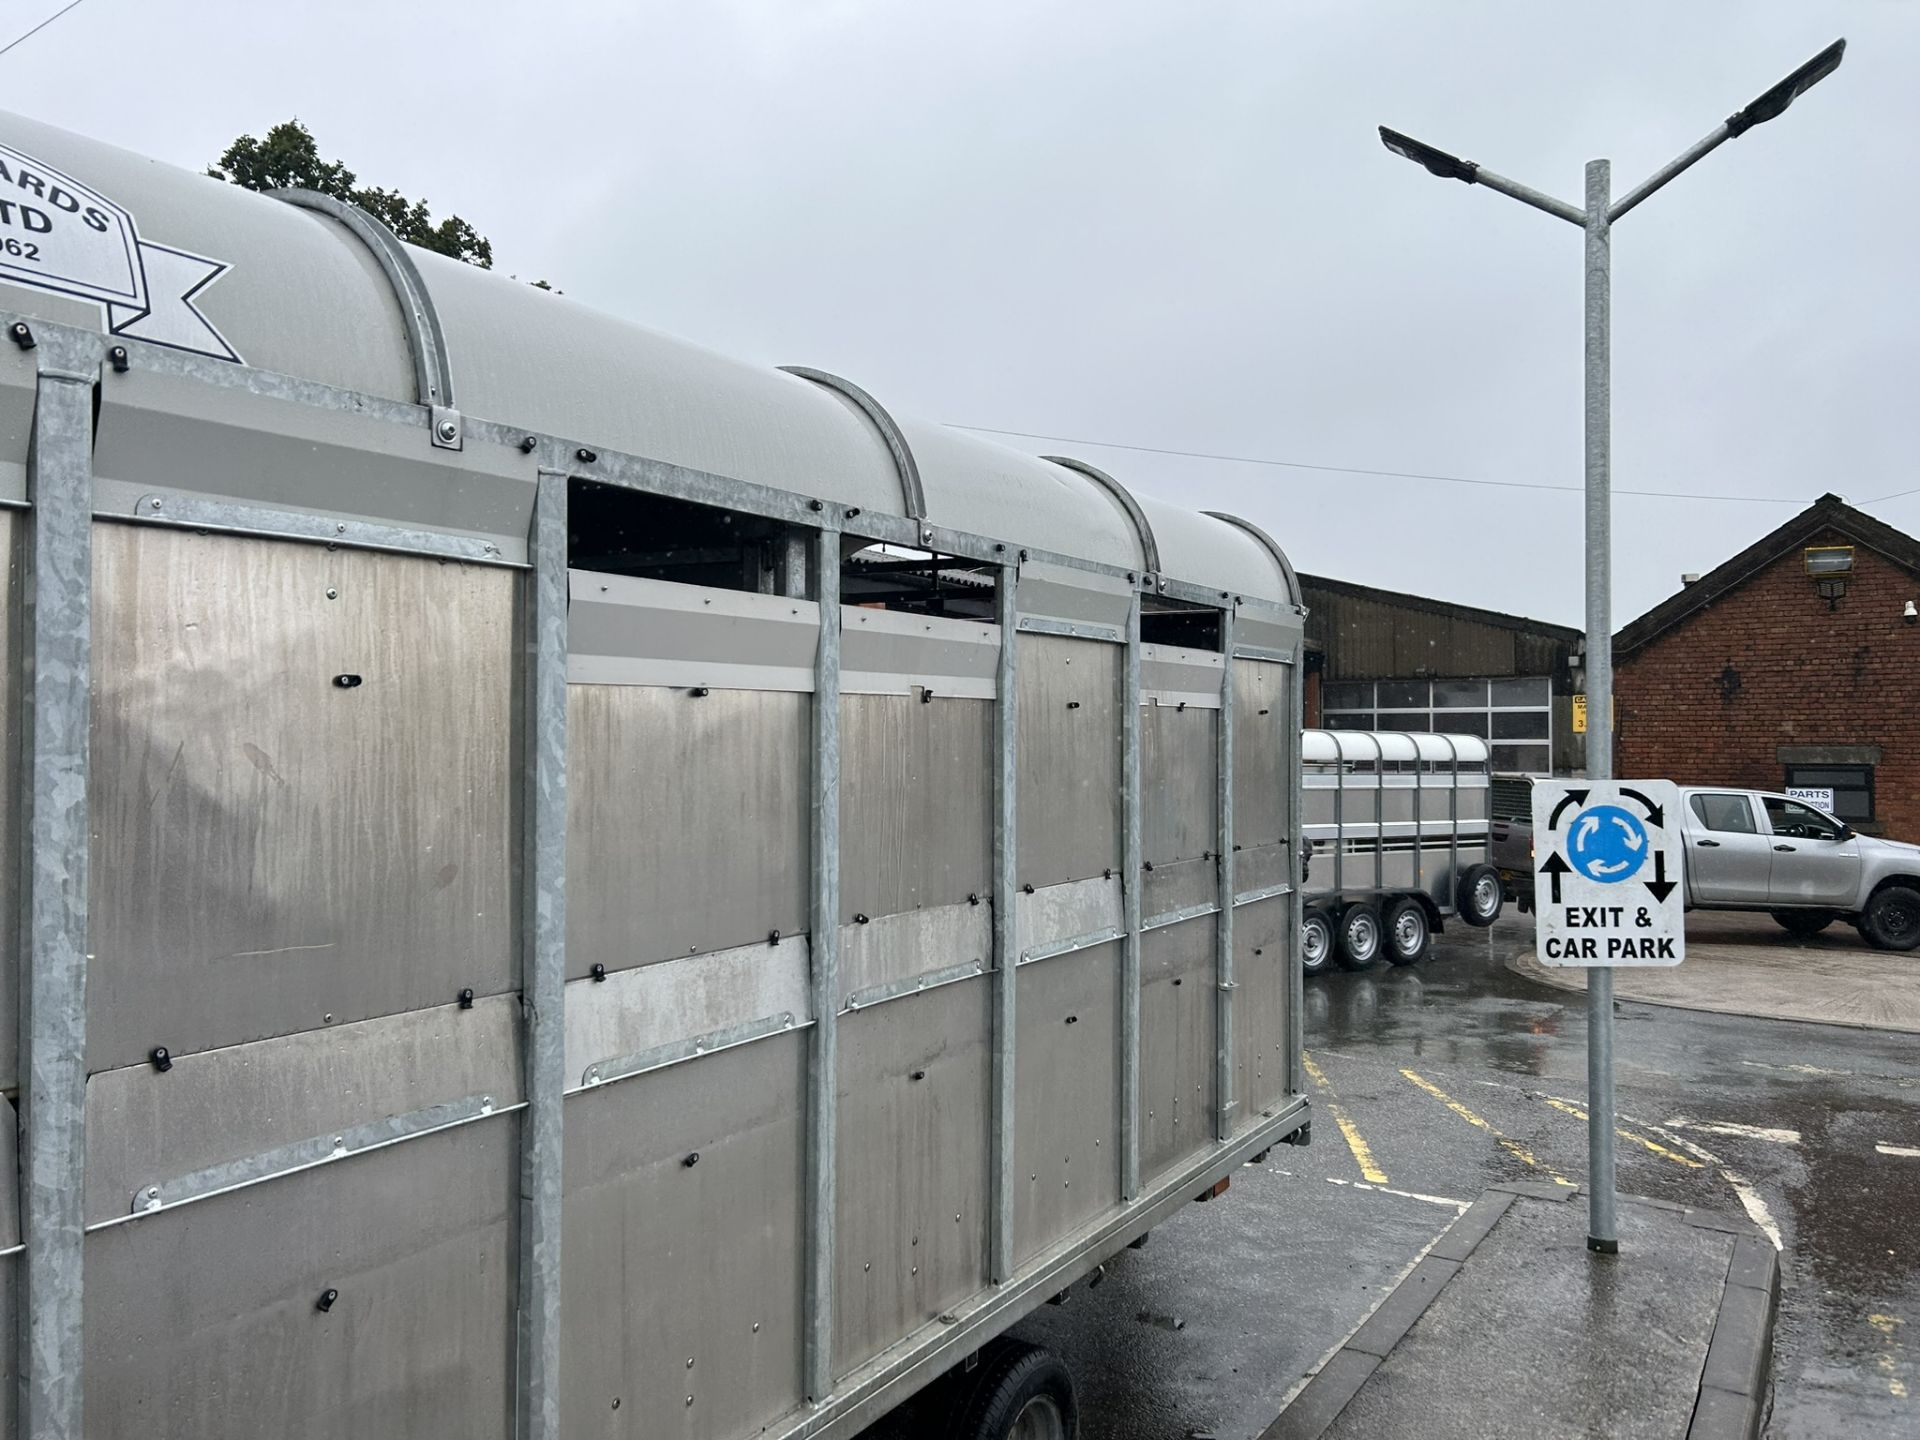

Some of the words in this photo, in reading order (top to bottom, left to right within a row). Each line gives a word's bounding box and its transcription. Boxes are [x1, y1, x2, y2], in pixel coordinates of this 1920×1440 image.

[0, 238, 40, 262] 62
[1790, 790, 1830, 799] PARTS
[1566, 907, 1624, 928] EXIT
[1635, 906, 1652, 928] &
[1546, 937, 1598, 959] CAR
[1607, 937, 1675, 959] PARK
